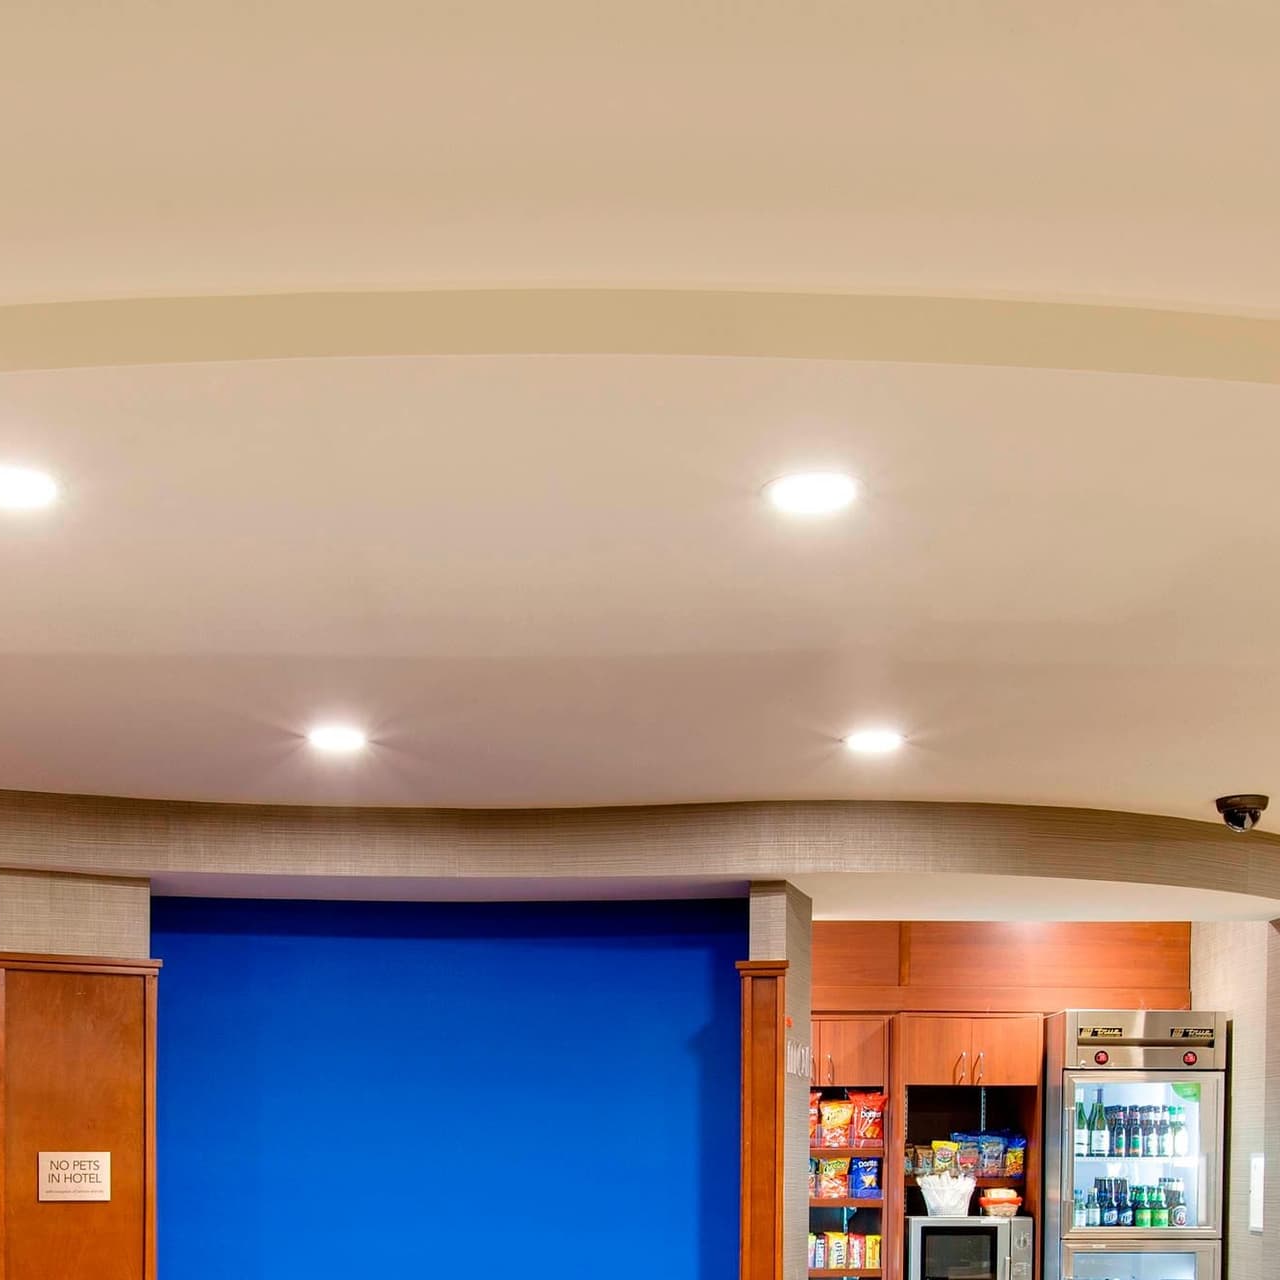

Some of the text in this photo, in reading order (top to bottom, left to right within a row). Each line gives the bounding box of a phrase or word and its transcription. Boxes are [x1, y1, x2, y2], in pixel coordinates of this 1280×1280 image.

[49, 1160, 100, 1170] NO PETS
[48, 1173, 102, 1184] IN HOTEL
